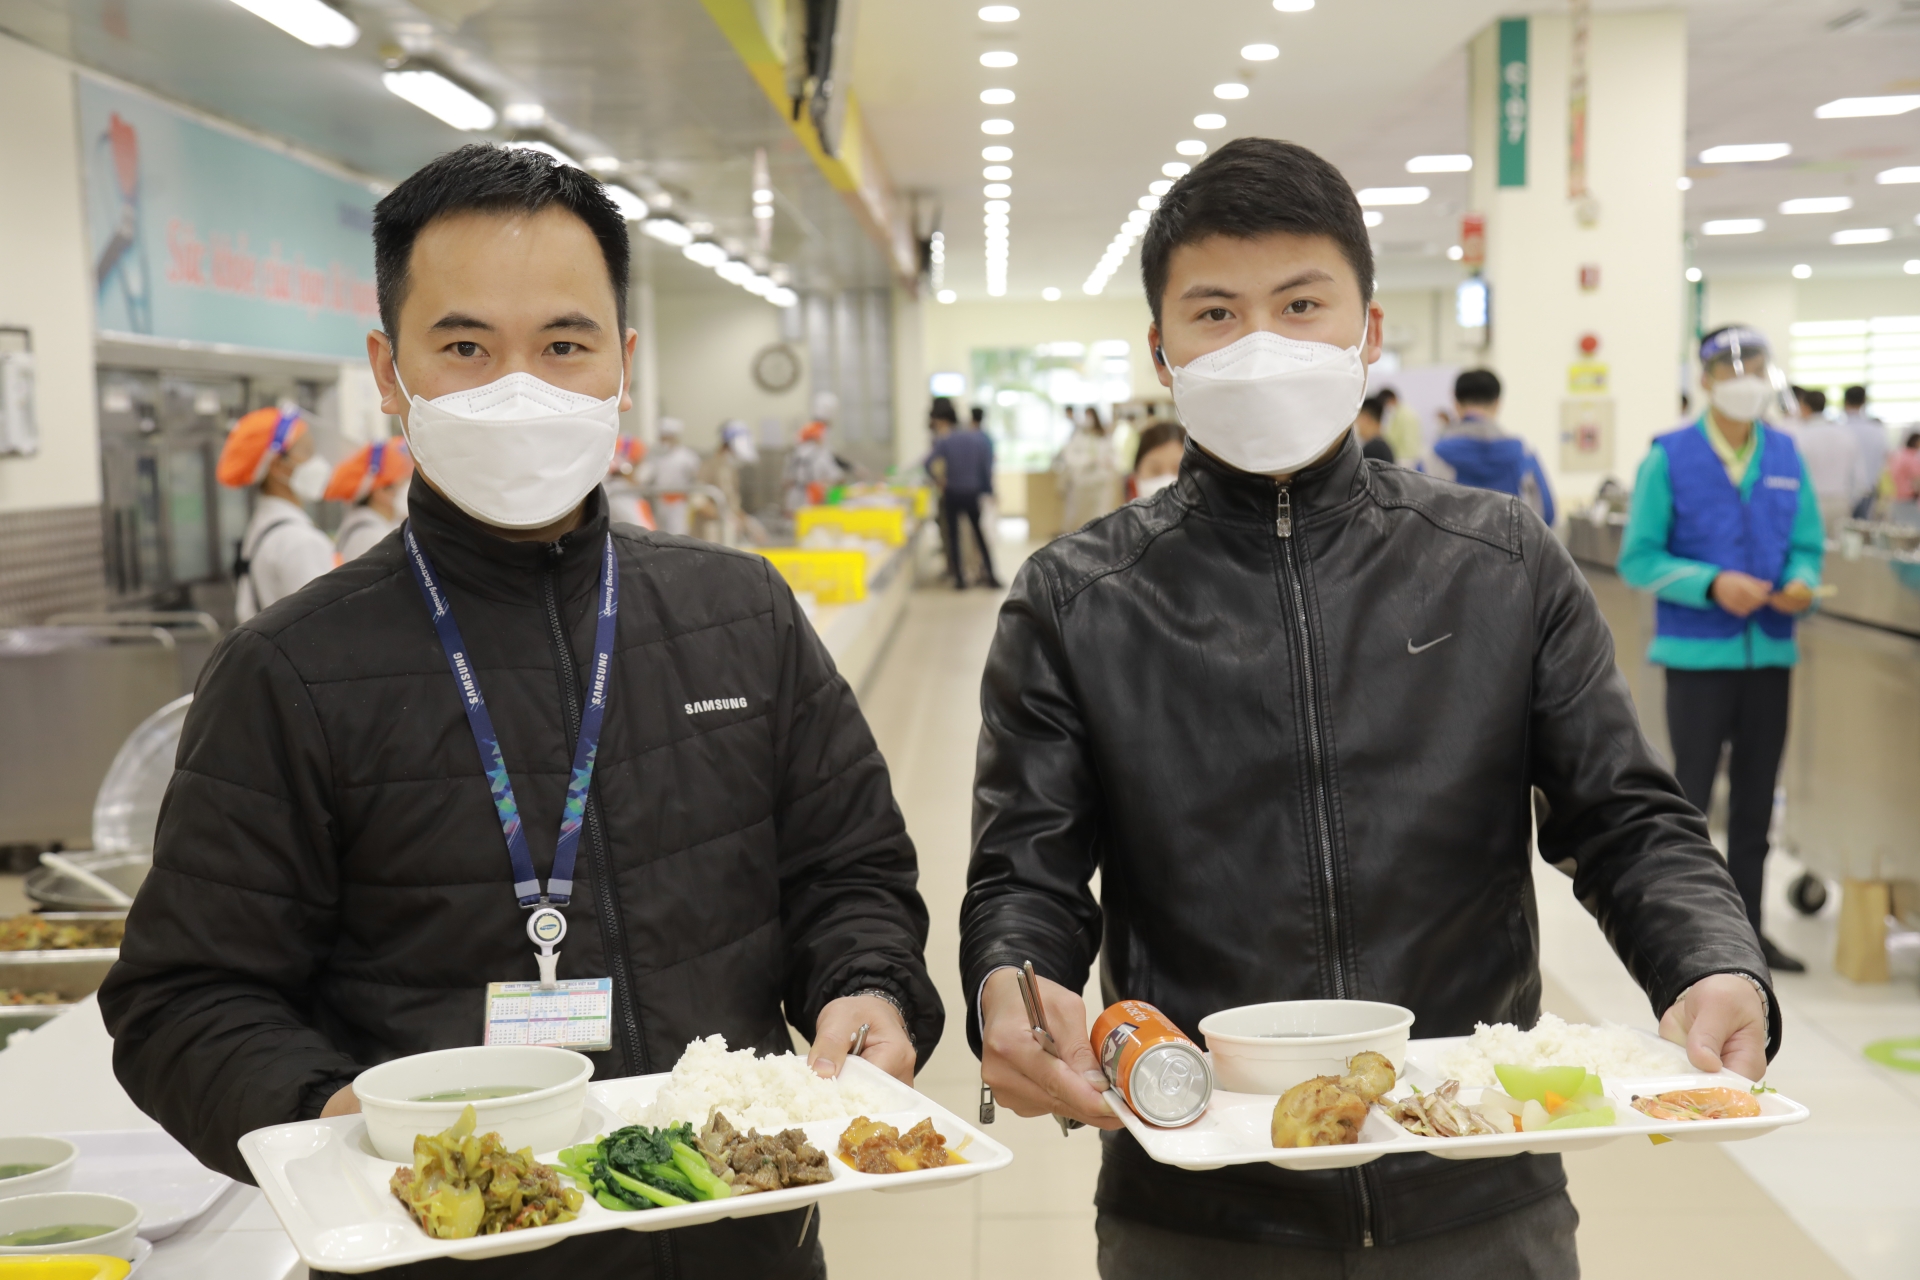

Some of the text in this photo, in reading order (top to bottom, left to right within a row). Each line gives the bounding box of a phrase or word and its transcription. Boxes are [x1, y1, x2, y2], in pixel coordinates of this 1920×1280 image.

[408, 531, 445, 616] Samsung Electronics Vietnam
[605, 554, 613, 587] Electronics
[604, 586, 614, 617] Samsung
[453, 652, 479, 704] SAMSUNG
[591, 652, 608, 705] SAMSUNG
[684, 697, 748, 715] SAMSUNG
